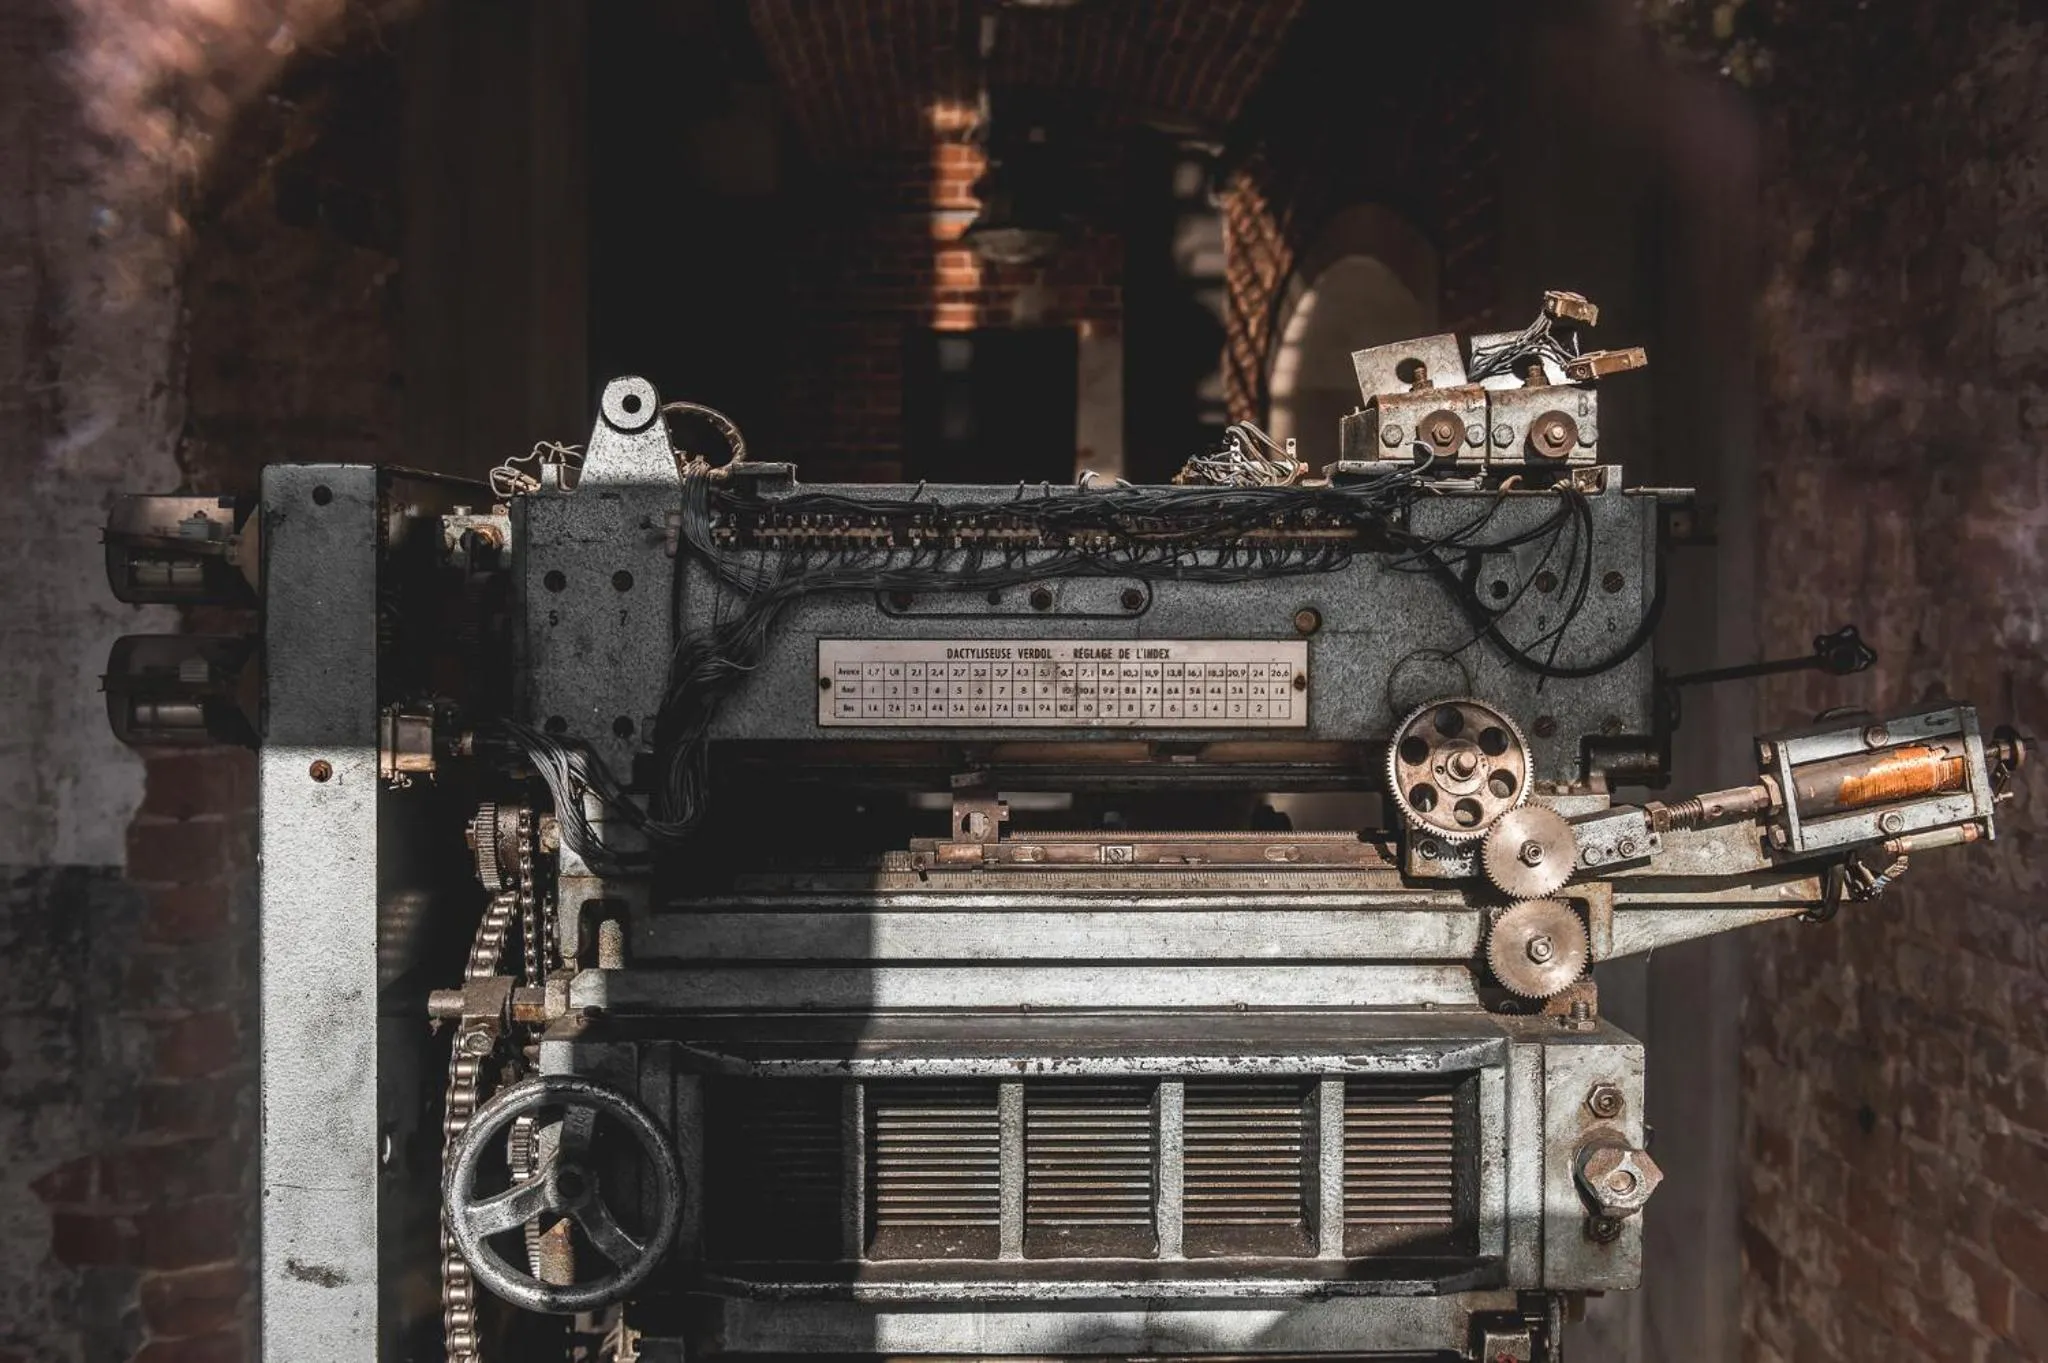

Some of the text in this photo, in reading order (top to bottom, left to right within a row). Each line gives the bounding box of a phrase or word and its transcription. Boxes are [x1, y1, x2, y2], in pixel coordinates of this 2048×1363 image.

[548, 609, 558, 628] 5
[619, 609, 628, 627] 7
[1538, 615, 1546, 632] 8
[946, 648, 1012, 659] DACTYLISEUSE
[1018, 648, 1052, 659] VERDOL
[1119, 648, 1131, 659] DE
[1136, 648, 1170, 659] L'INDEX
